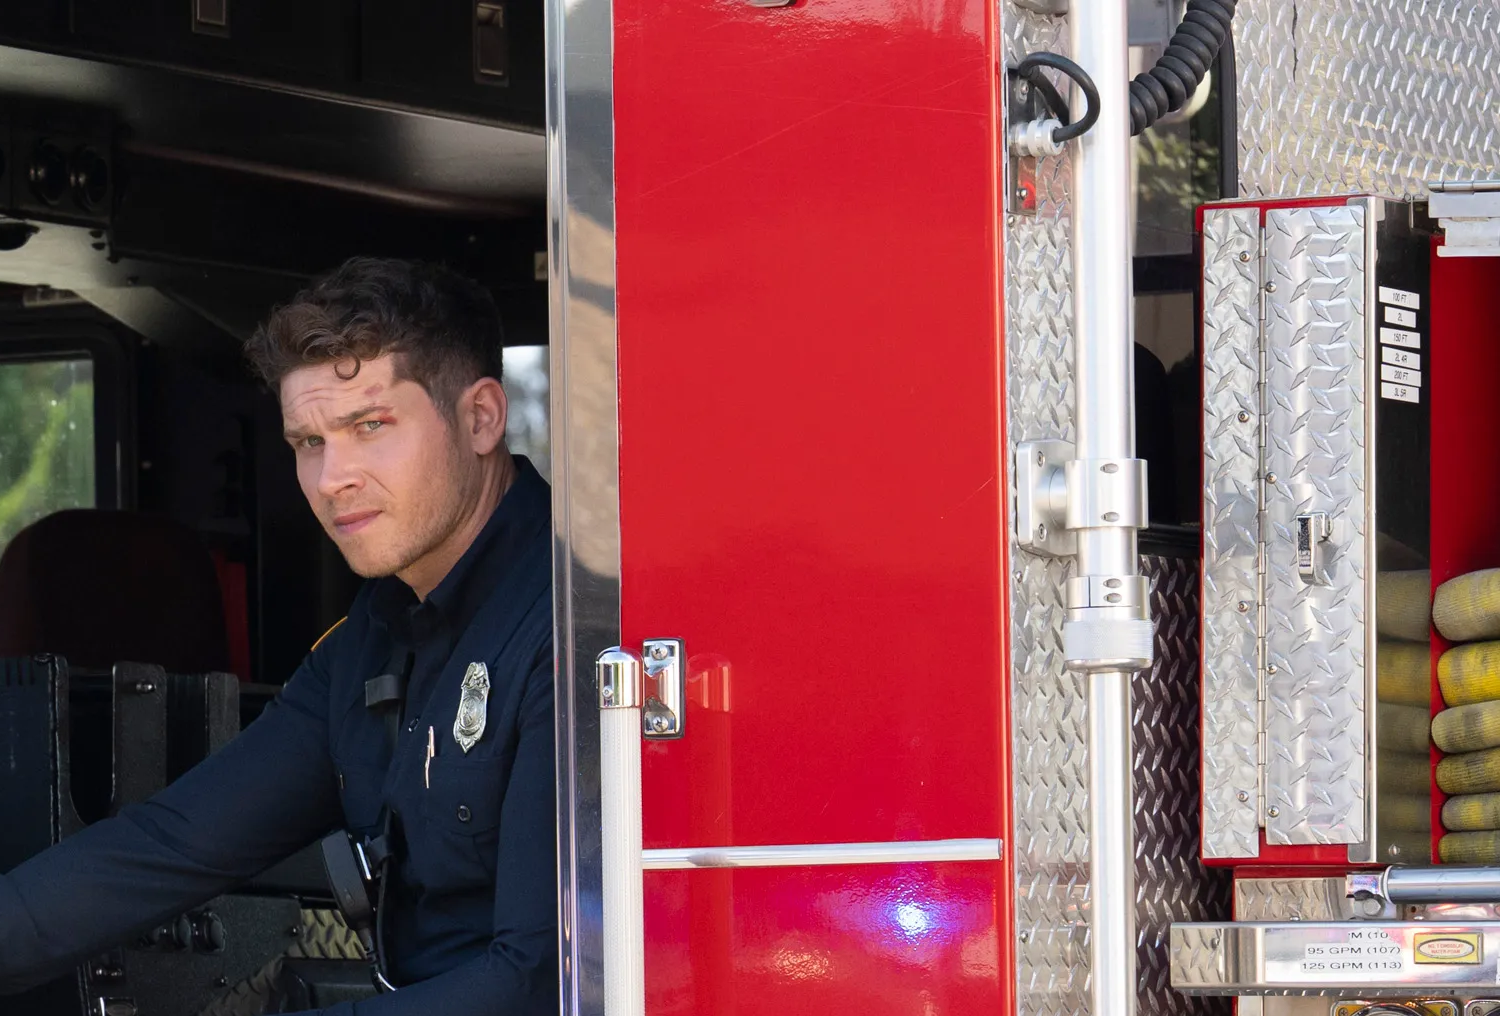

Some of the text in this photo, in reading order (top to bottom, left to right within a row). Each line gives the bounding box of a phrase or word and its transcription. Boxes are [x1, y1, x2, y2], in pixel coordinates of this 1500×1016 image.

[1392, 292, 1407, 303] 100 FT
[1397, 312, 1403, 322] 2L
[1394, 333, 1408, 343] 150 FT
[1395, 352, 1408, 364] 2L 4R
[1394, 370, 1408, 381] 200 FT
[1394, 388, 1400, 397] 3L
[1329, 946, 1362, 954] GPM
[1367, 946, 1401, 954] (107)
[1302, 962, 1402, 970] 125 GPM (113)
